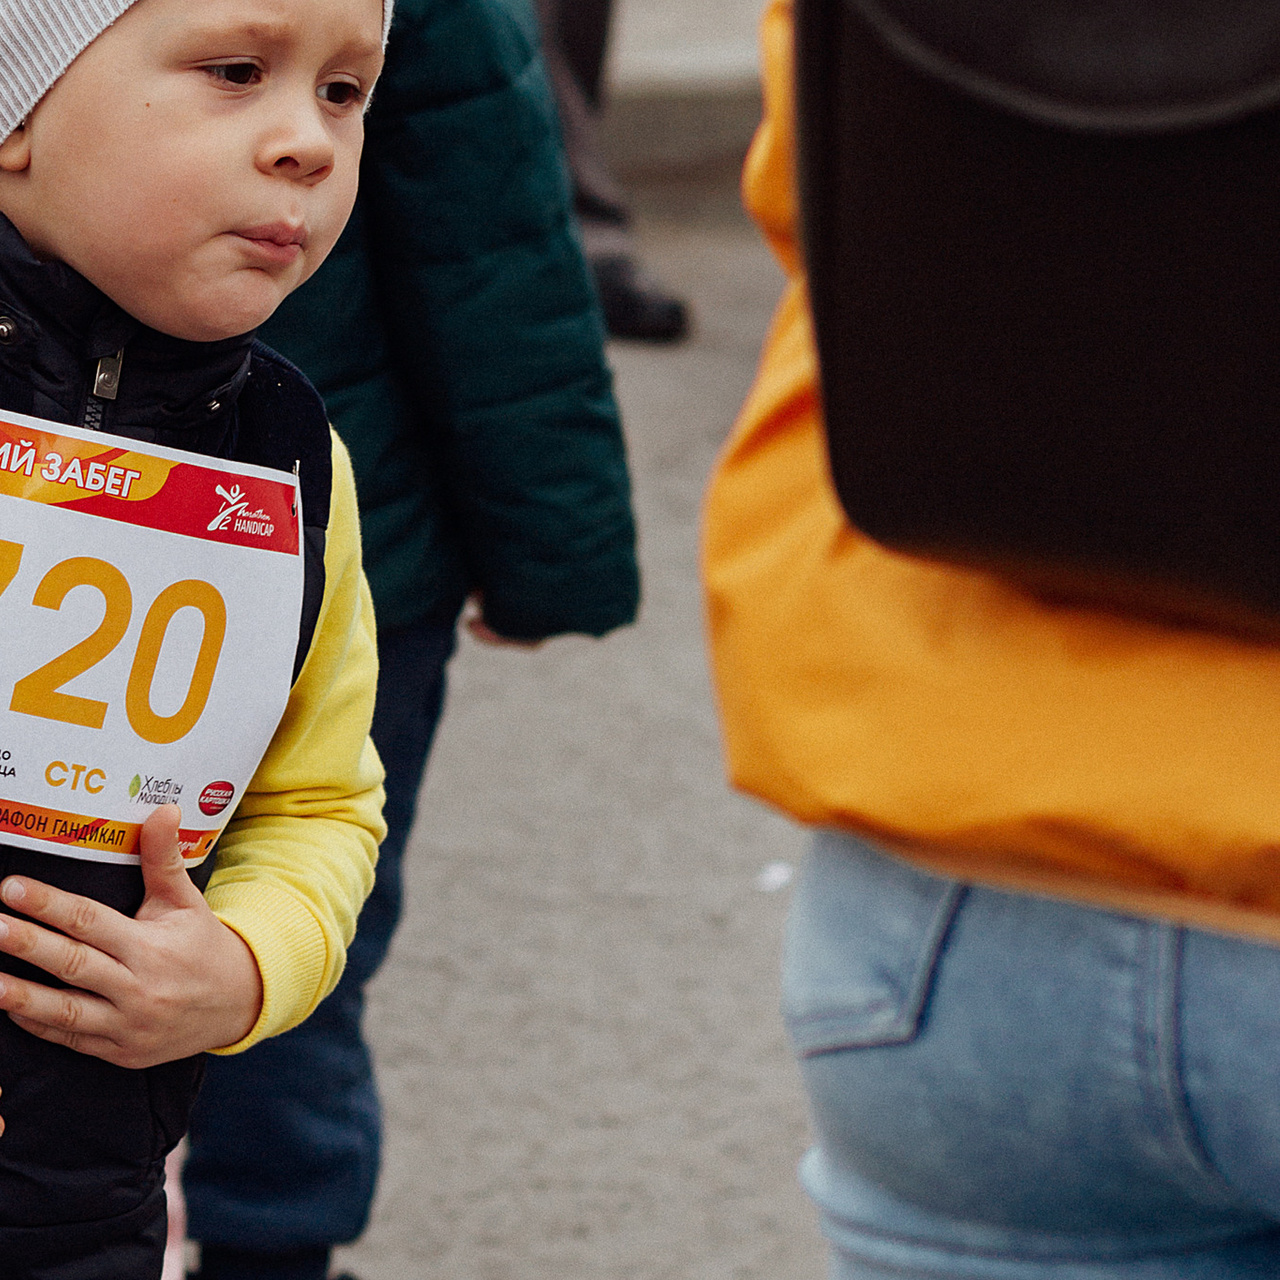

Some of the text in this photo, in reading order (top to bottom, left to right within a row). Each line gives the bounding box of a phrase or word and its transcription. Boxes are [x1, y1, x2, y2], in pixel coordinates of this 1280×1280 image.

[41, 453, 141, 498] ЗАБЕГ
[233, 518, 275, 537] HANDICAP
[44, 760, 107, 794] СТС
[51, 819, 126, 846] ГАНДИКАП
